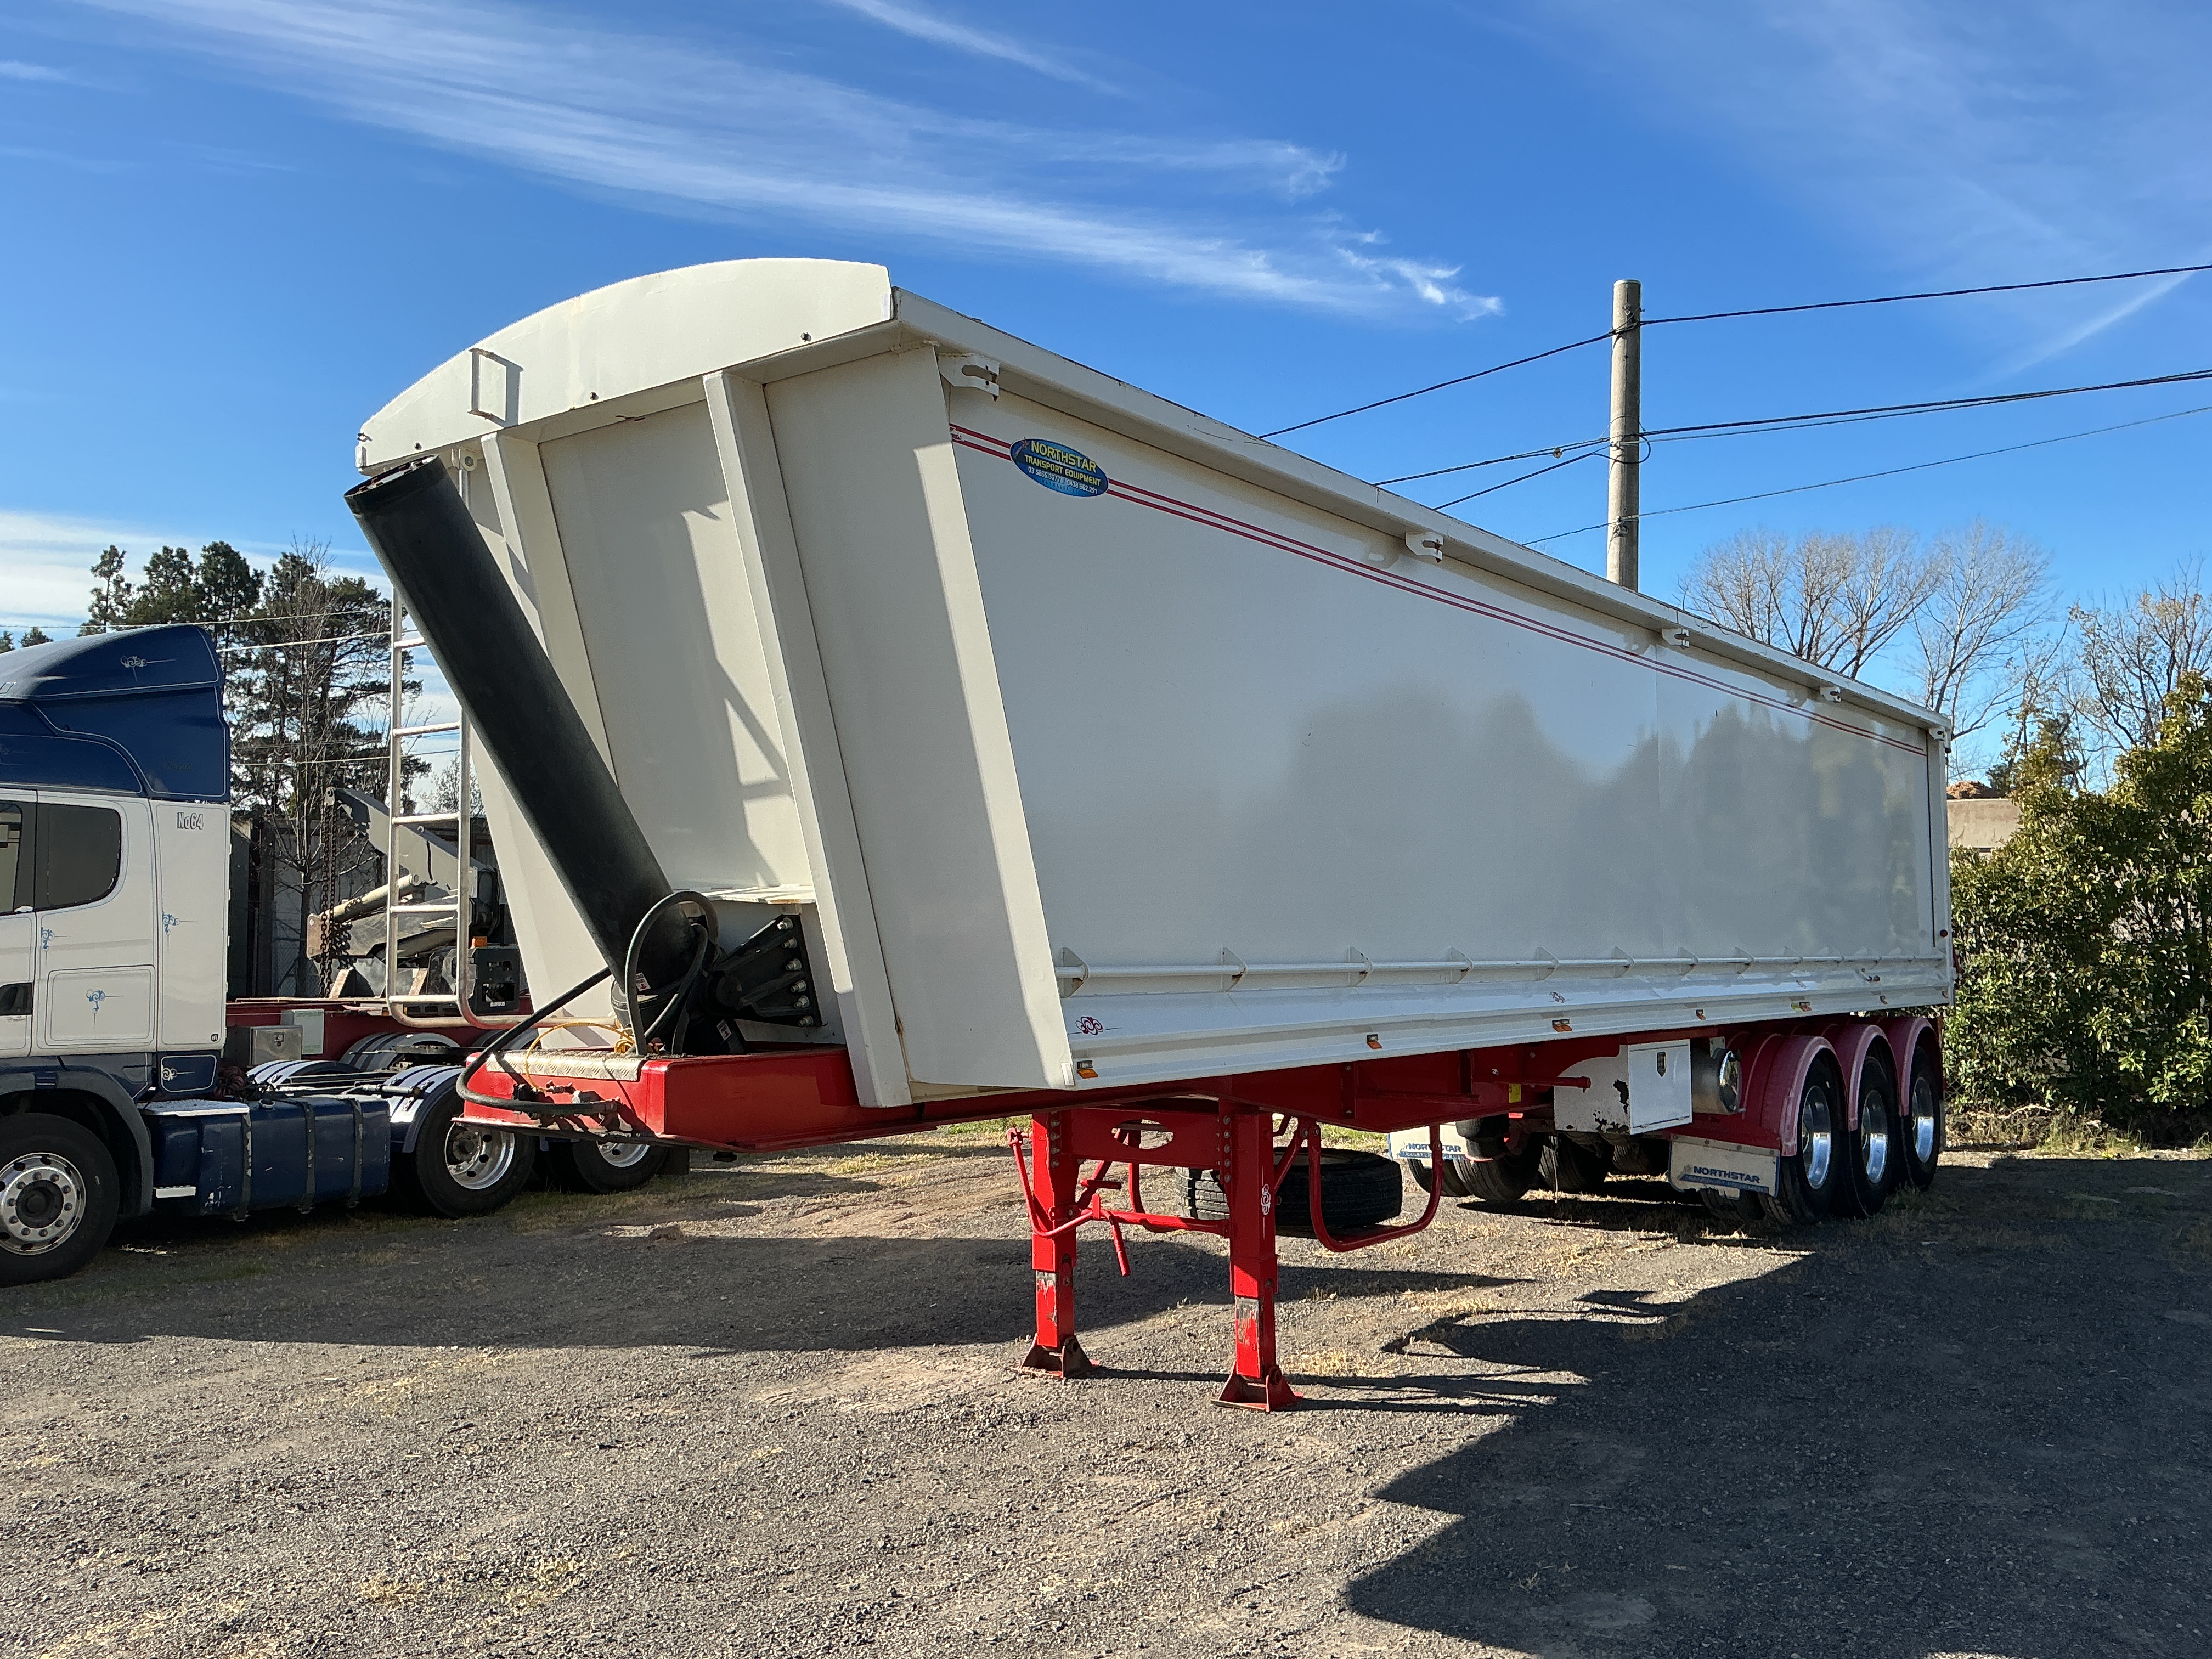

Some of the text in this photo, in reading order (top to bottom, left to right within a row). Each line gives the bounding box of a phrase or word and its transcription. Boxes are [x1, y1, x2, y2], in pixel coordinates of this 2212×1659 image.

[1031, 441, 1097, 473] NORTHSTAR
[1024, 454, 1101, 486] TRANSPORT EQUIPMENT
[177, 812, 204, 830] No64
[1408, 1143, 1462, 1153] NORTAR
[1694, 1166, 1760, 1184] NORTHSTAR
